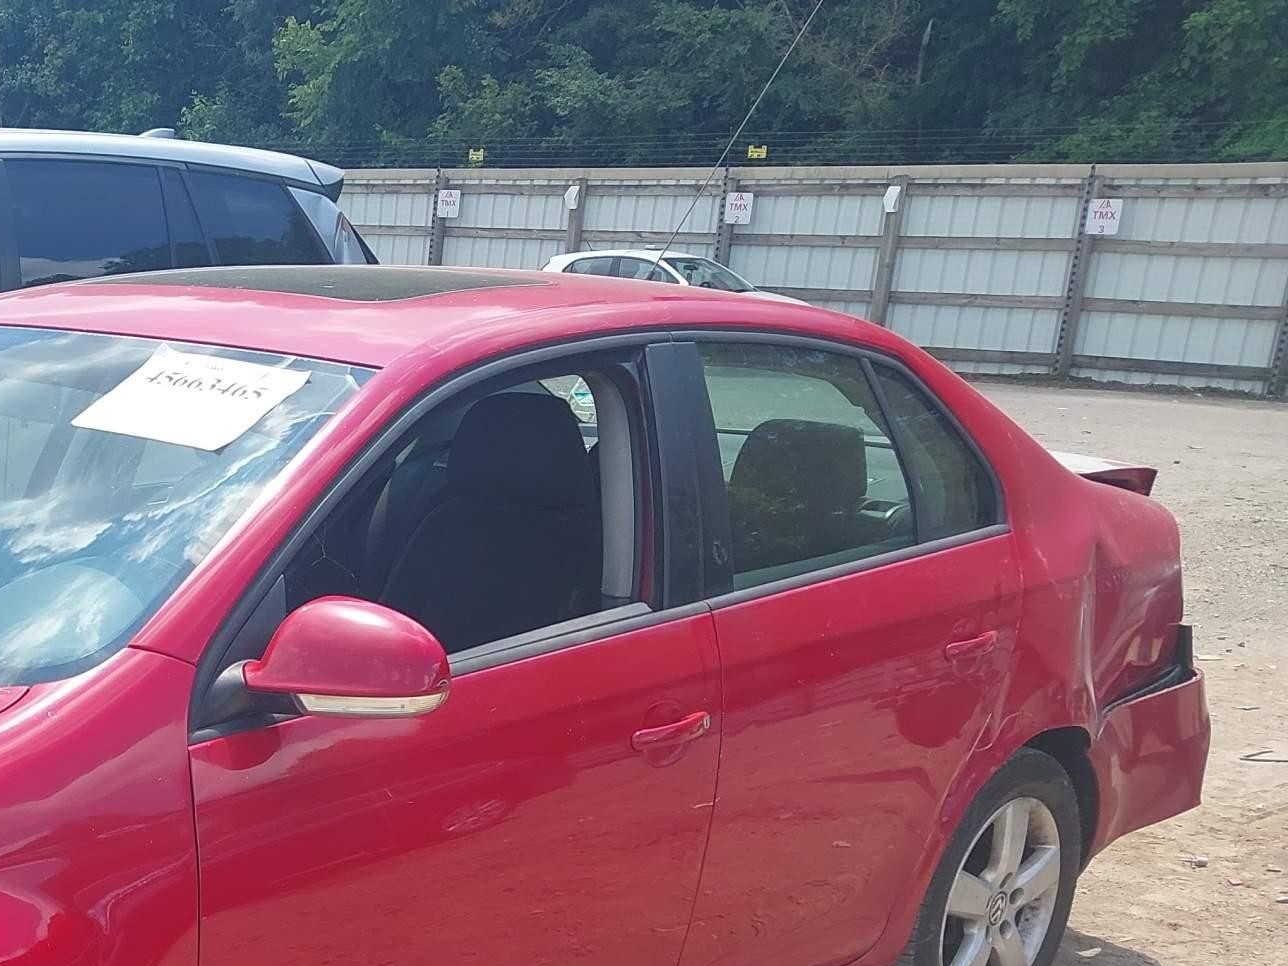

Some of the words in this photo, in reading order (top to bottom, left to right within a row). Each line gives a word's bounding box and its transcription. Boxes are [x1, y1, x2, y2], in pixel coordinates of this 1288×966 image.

[729, 203, 748, 211] TMX
[1093, 210, 1117, 220] TMX
[1098, 225, 1105, 233] 3
[146, 371, 270, 399] 45663465
